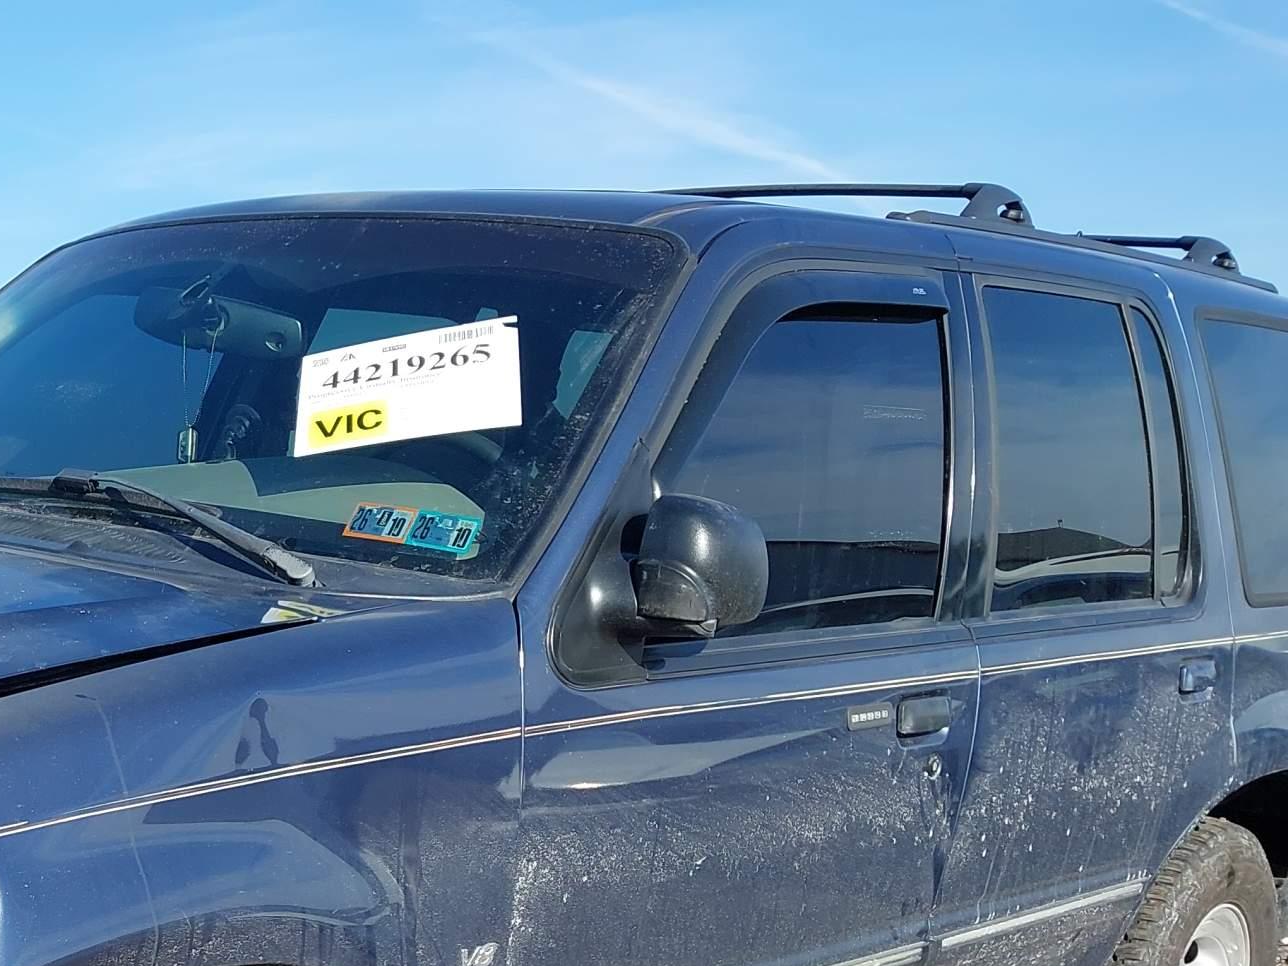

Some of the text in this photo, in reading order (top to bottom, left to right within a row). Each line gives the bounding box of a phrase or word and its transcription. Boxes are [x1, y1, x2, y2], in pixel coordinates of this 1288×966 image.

[322, 343, 492, 389] 44219265
[315, 409, 383, 438] VIC
[350, 508, 372, 532] 26
[412, 516, 435, 540] 26
[452, 526, 472, 549] 10
